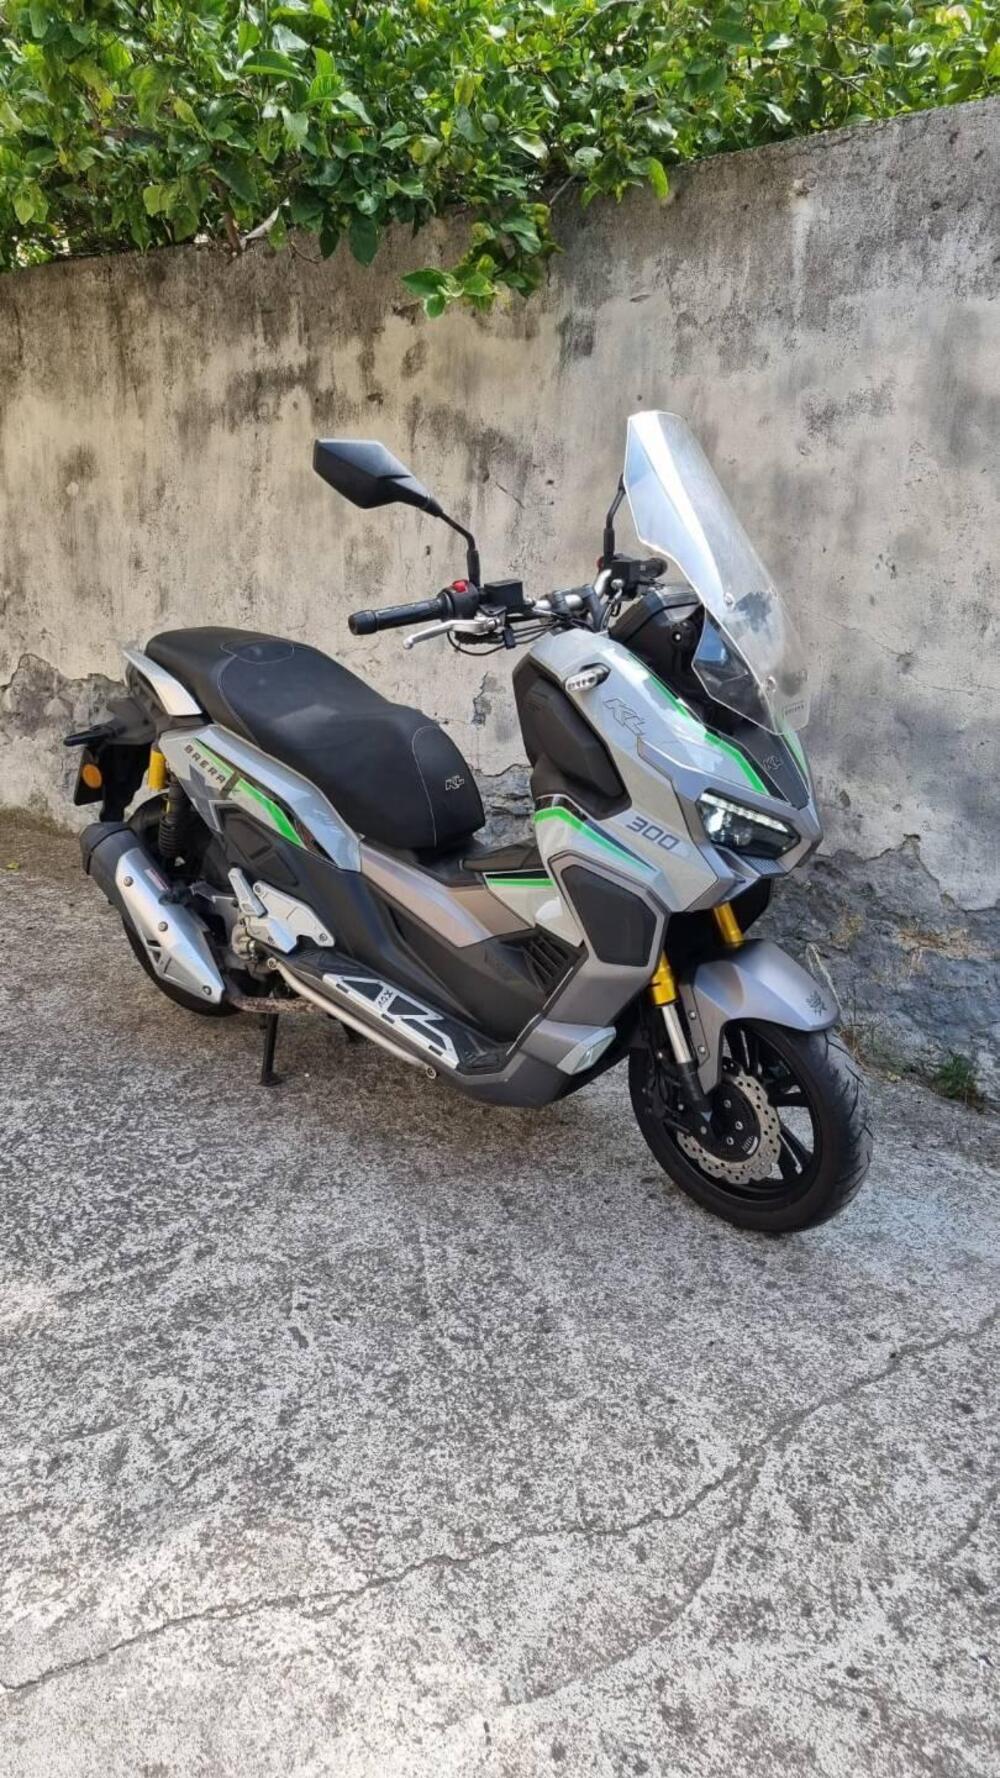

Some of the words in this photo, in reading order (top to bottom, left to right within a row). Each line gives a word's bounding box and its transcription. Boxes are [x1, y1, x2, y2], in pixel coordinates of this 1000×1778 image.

[602, 697, 645, 737] KL
[184, 744, 226, 783] BRERA
[626, 816, 680, 850] 300
